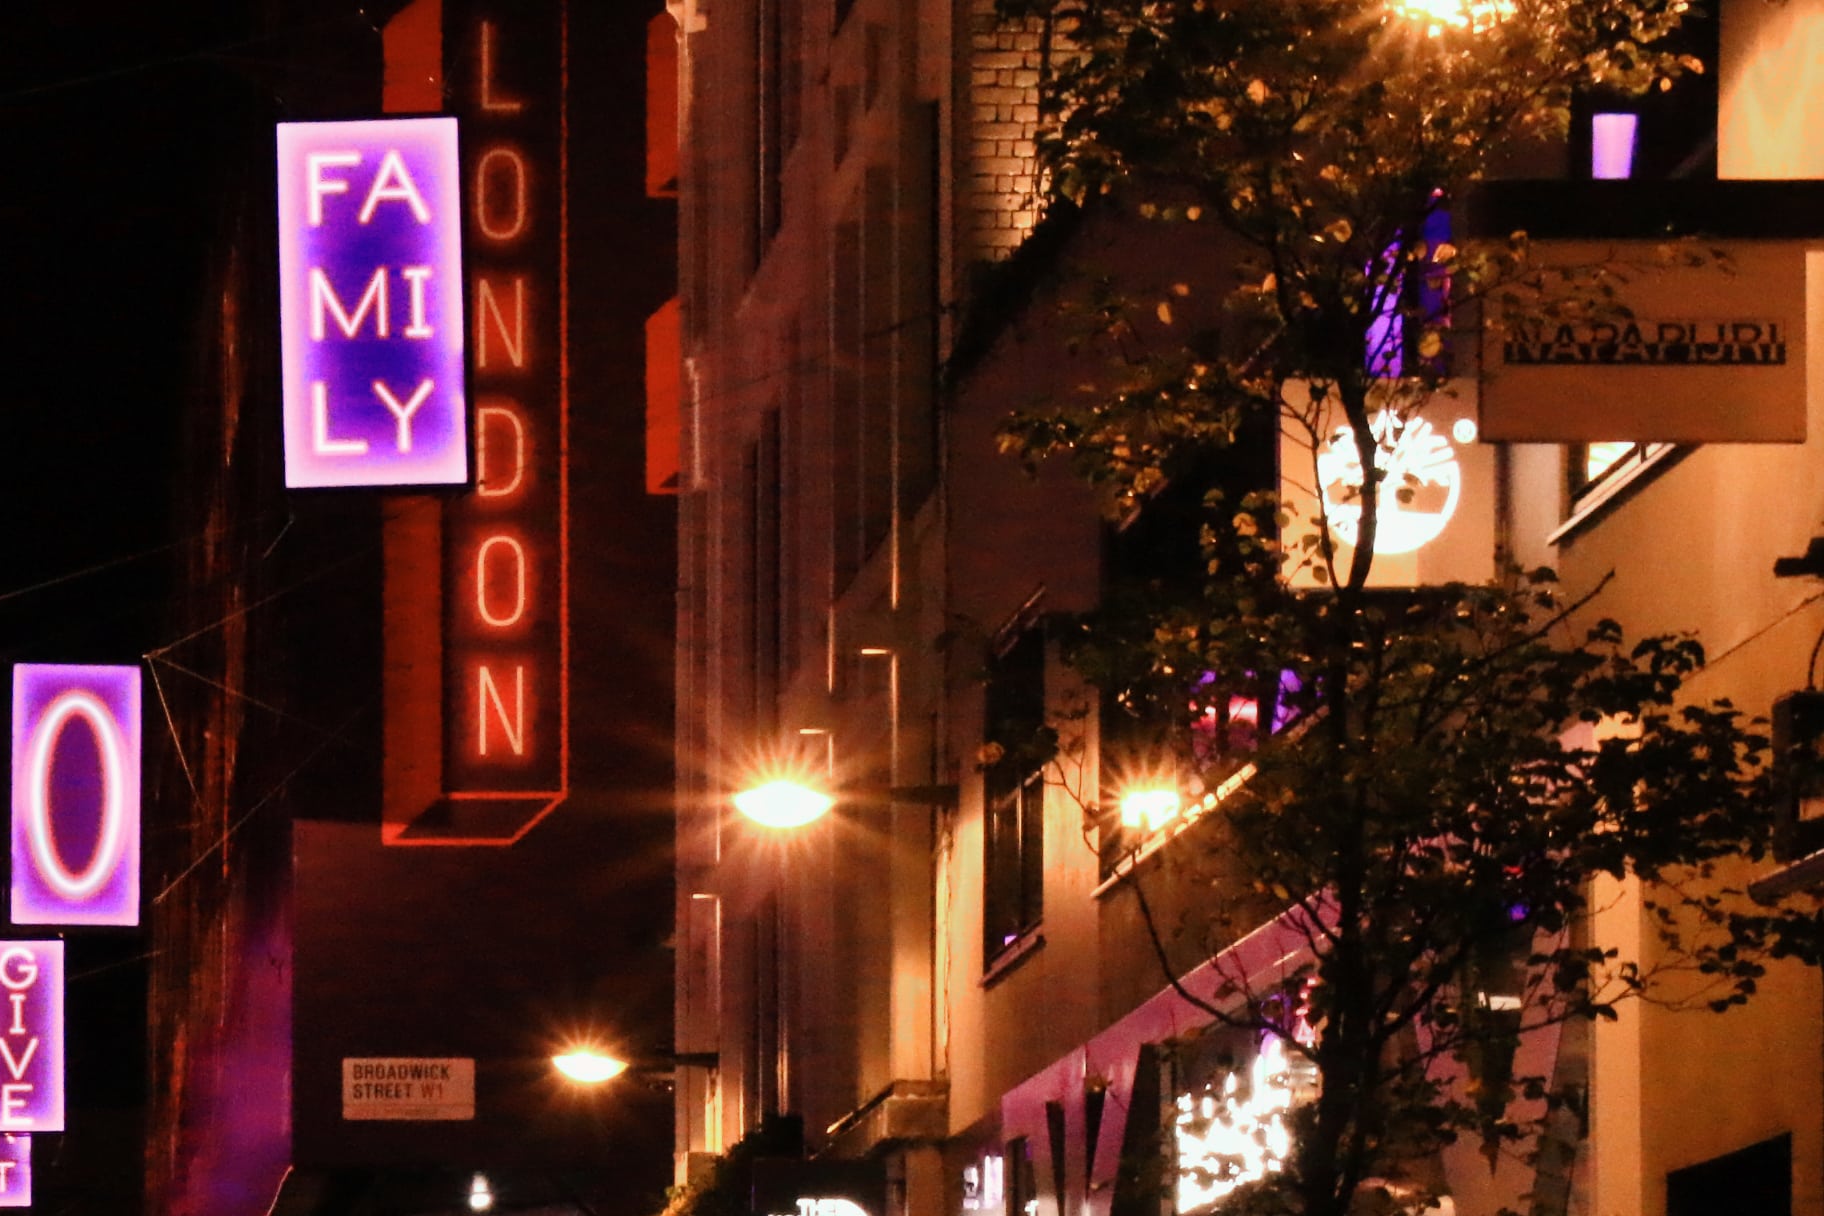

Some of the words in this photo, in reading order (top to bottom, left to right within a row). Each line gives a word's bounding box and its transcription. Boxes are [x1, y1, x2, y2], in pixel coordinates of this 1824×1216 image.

[475, 20, 526, 757] LONDON
[353, 1064, 450, 1080] BROADWICK
[353, 1083, 411, 1099] STREET
[421, 1083, 444, 1099] W1
